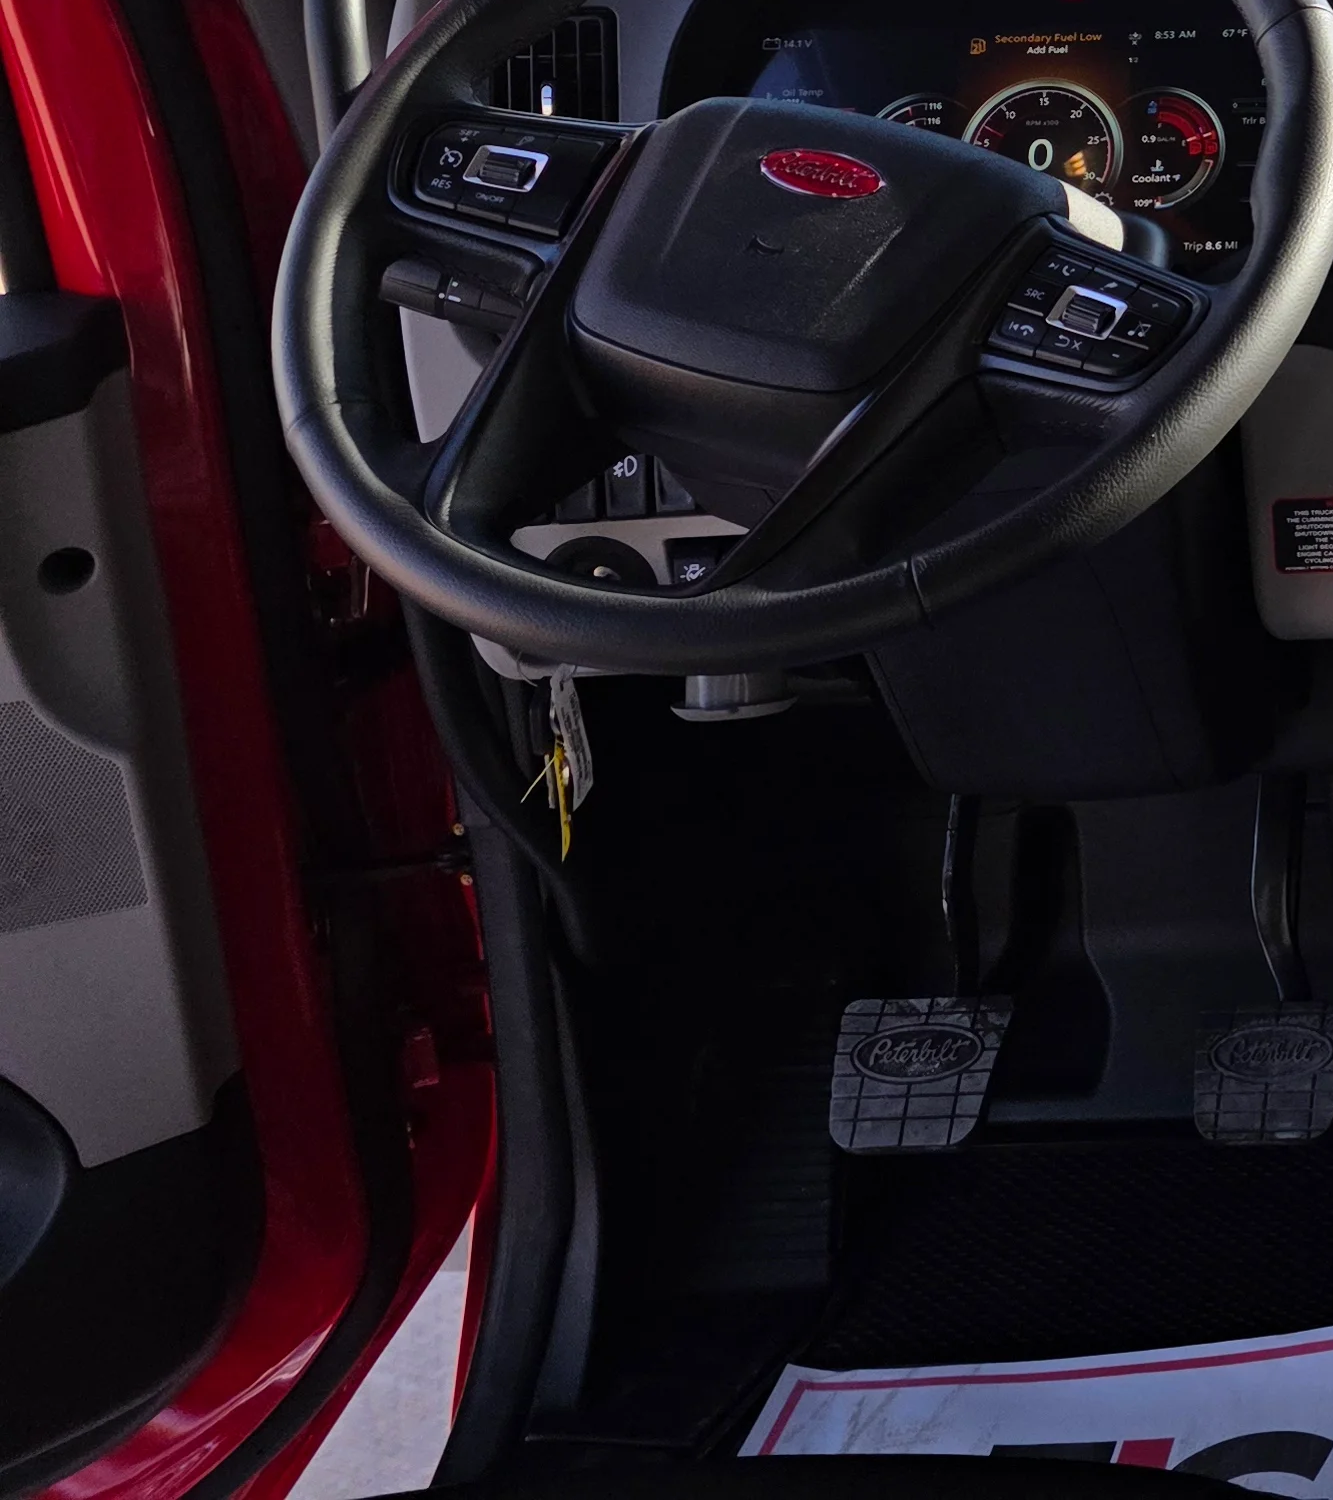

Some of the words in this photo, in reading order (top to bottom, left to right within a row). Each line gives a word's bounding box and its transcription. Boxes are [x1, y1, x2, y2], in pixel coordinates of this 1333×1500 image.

[1154, 30, 1175, 40] 8:53
[1178, 30, 1196, 38] AM
[1222, 28, 1234, 38] 67
[804, 39, 813, 48] V
[994, 34, 1051, 45] Secondary
[1054, 32, 1077, 42] Fuel
[1079, 32, 1103, 41] Low
[1026, 45, 1046, 55] Add
[1048, 45, 1069, 54] Fuel
[928, 102, 943, 110] 116
[1039, 97, 1050, 106] 15
[1005, 111, 1016, 120] 10
[1070, 109, 1083, 119] 20
[928, 117, 941, 125] 116
[458, 129, 480, 137] SET
[983, 138, 990, 147] 5
[1087, 136, 1100, 145] 25
[1141, 134, 1157, 143] 0.9
[1028, 138, 1054, 172] 0
[1083, 172, 1096, 180] 30
[1131, 173, 1171, 183] Coolant
[431, 177, 452, 189] RES
[1183, 241, 1204, 253] Trip
[1205, 241, 1222, 250] 8.6
[1224, 241, 1239, 249] MI
[1024, 288, 1045, 301] SRC
[868, 1035, 972, 1065] Peterbilt
